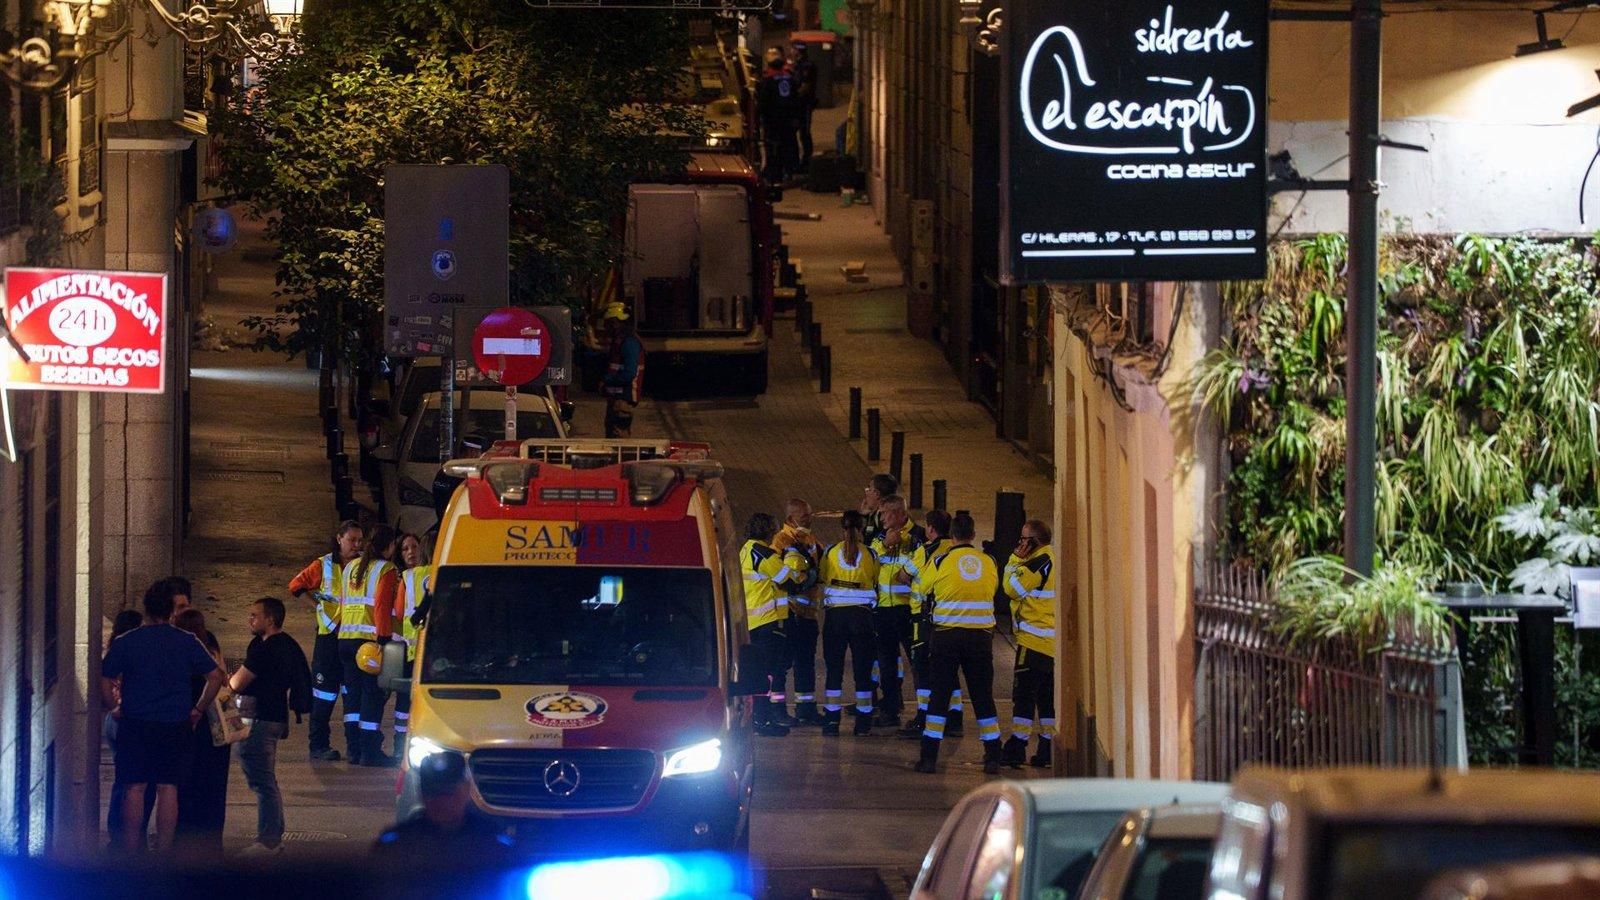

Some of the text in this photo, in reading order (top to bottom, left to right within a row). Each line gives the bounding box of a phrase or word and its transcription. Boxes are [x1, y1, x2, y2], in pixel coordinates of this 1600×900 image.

[1135, 4, 1254, 54] sidrería
[1042, 53, 1232, 154] el escarpín
[1106, 163, 1256, 179] cocina astur
[10, 273, 161, 336] ALIMENTACIÓN
[58, 307, 107, 331] 24h
[93, 347, 160, 368] SECOS
[40, 364, 129, 386] BEBIDAS
[505, 525, 651, 552] SAMUR
